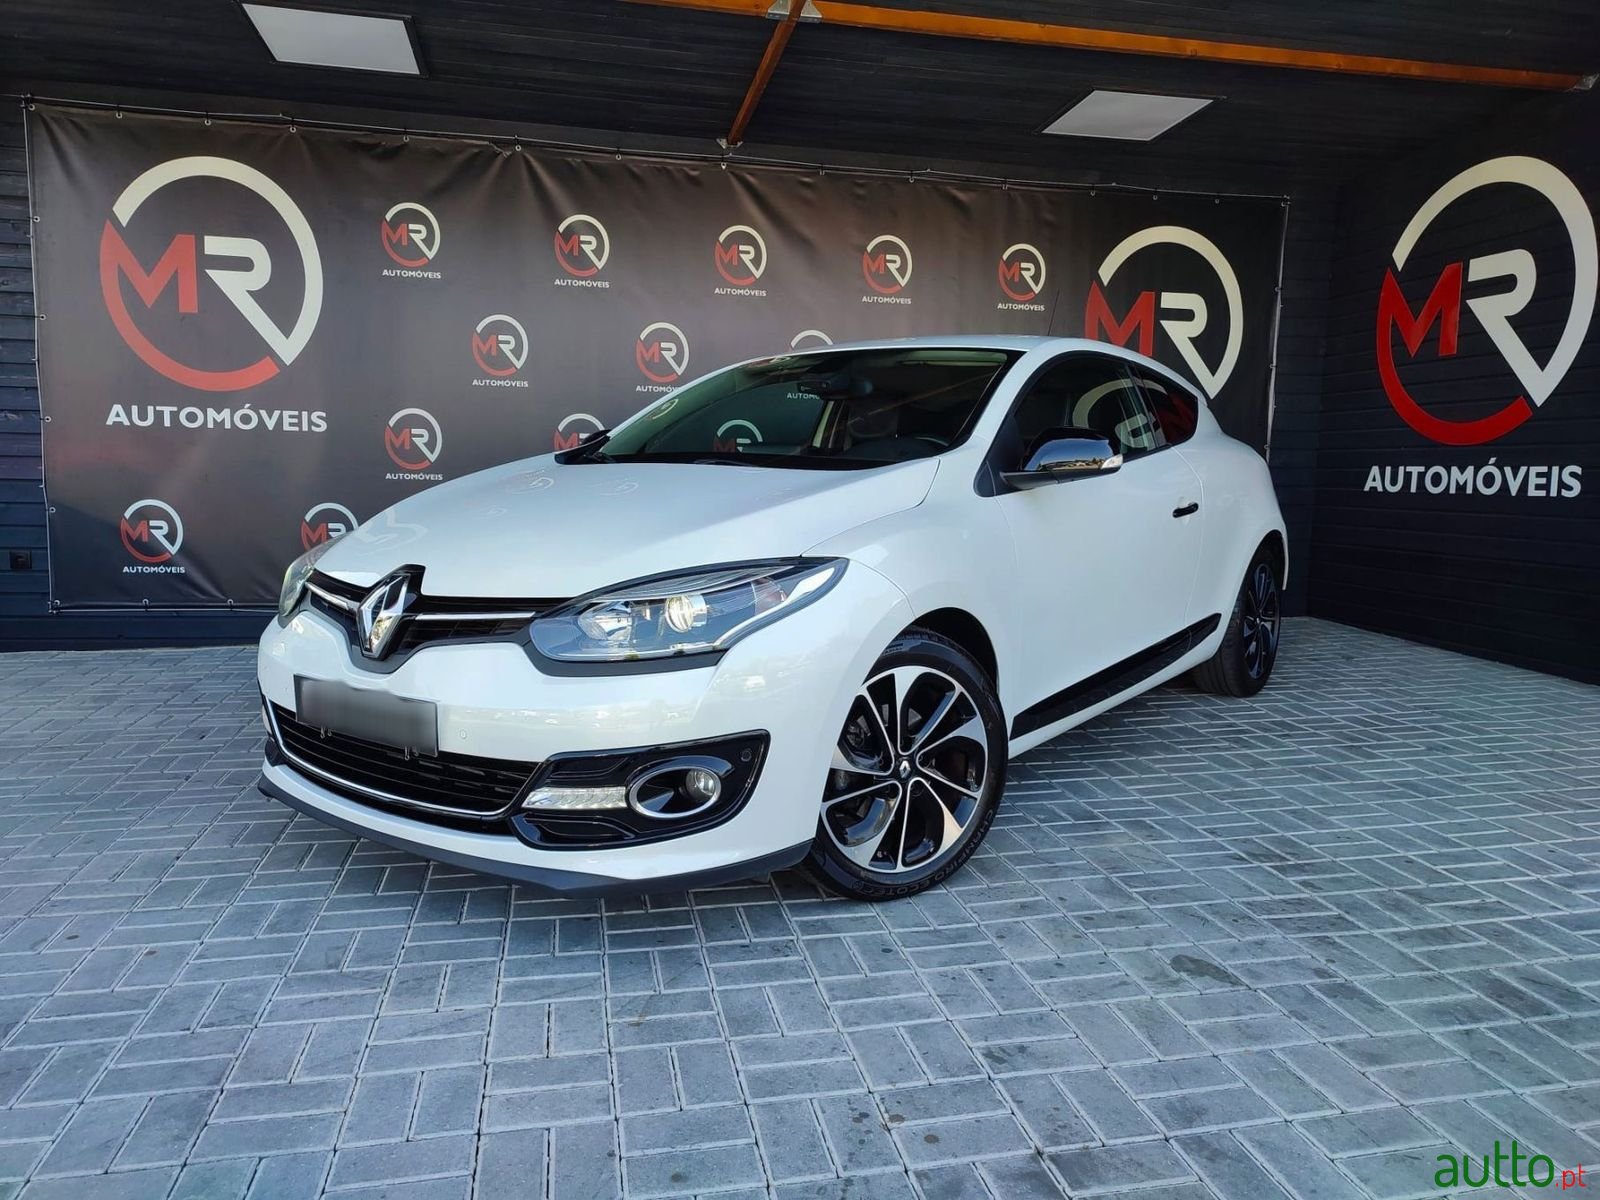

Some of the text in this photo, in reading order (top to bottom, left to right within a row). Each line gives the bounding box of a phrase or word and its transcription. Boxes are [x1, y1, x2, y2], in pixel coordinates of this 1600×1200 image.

[381, 220, 435, 261] MR
[555, 231, 605, 270] MR
[382, 268, 442, 279] AUTOMÓVEIS
[715, 241, 764, 279] MR
[863, 252, 907, 288] MR
[999, 259, 1040, 295] MR
[102, 221, 292, 365] MR
[554, 277, 610, 289] AUTOMÓVEIS
[714, 287, 767, 298] AUTOMÓVEIS
[862, 295, 912, 306] AUTOMÓVEIS
[997, 302, 1045, 312] AUTOMÓVEIS
[1377, 248, 1545, 407] MR
[472, 332, 522, 369] MR
[636, 338, 683, 376] MR
[472, 378, 529, 388] AUTOMÓVEIS
[106, 403, 327, 433] AUTOMÓVEIS
[385, 426, 437, 463] MR
[385, 472, 443, 482] AUTOMÓVEIS
[1364, 457, 1582, 498] AUTOMÓVEIS
[121, 518, 177, 555] MR
[122, 565, 186, 575] AUTOMÓVEIS
